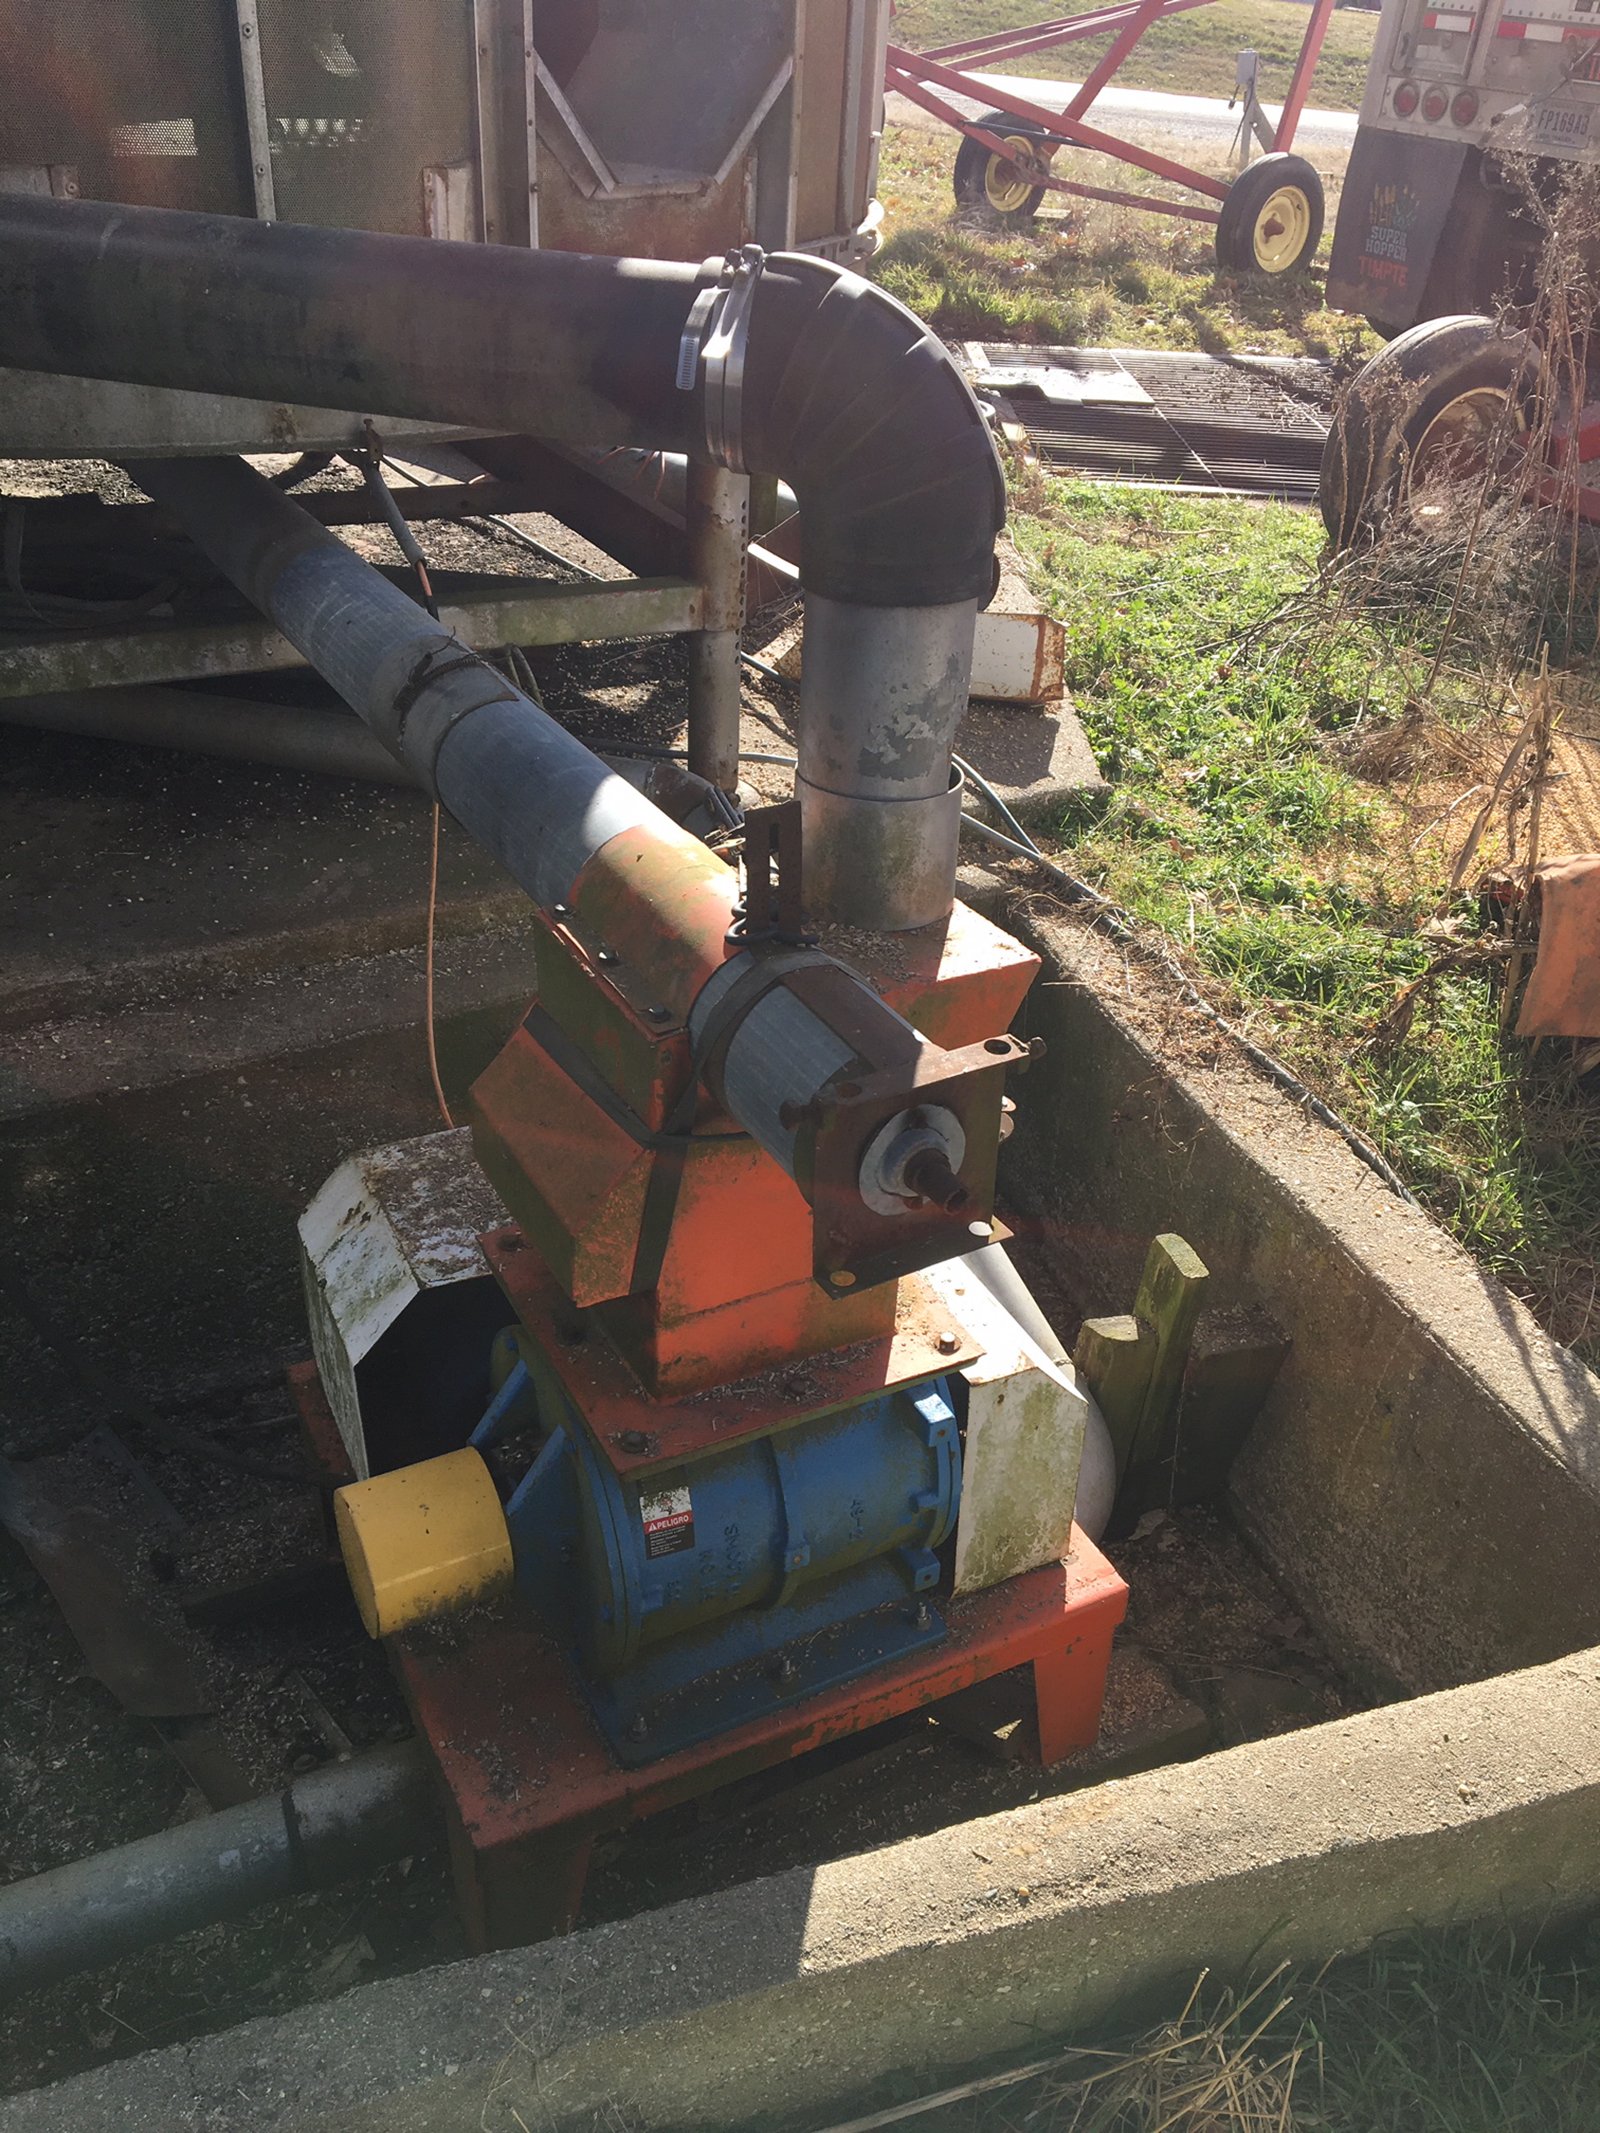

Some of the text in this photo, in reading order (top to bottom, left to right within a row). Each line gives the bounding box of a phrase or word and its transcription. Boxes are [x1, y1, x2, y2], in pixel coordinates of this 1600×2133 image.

[1370, 225, 1408, 247] SUPER
[1365, 238, 1408, 262] HOPPER
[1358, 255, 1409, 289] TIMPTE
[656, 1514, 689, 1529] PELIGRO
